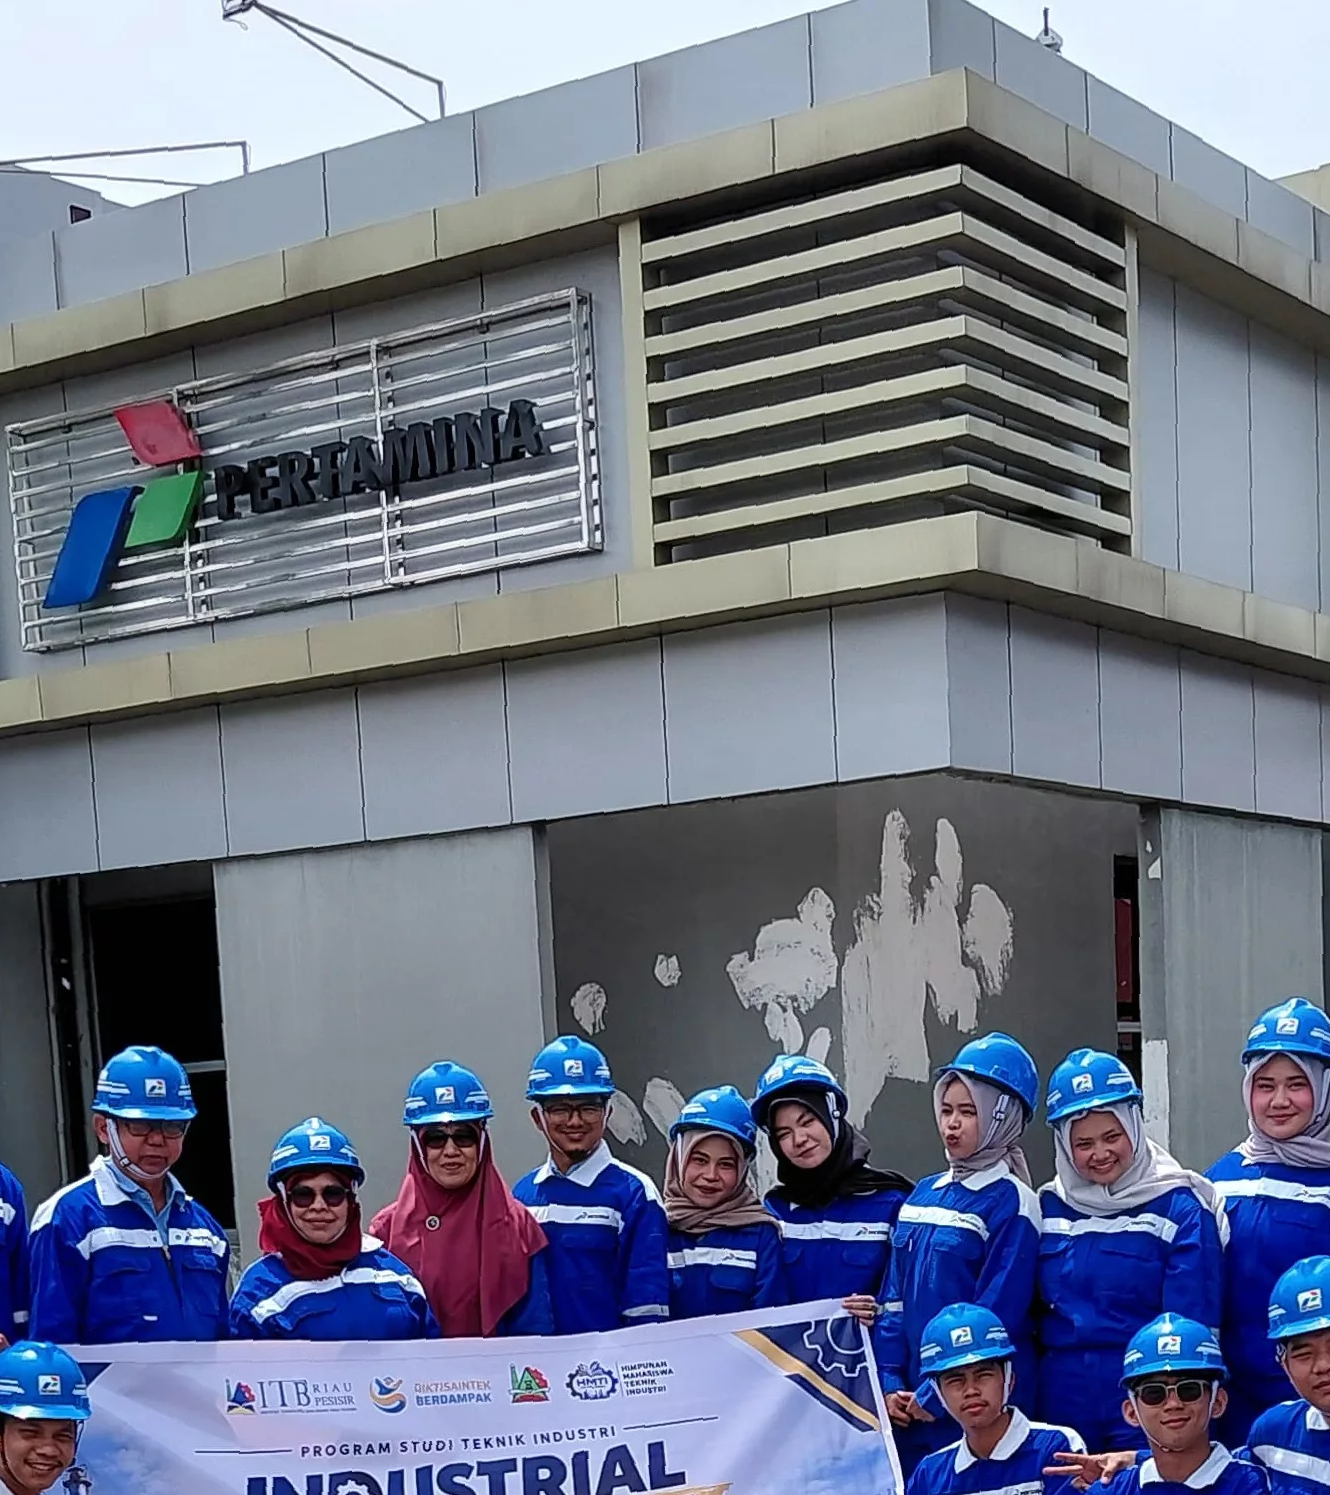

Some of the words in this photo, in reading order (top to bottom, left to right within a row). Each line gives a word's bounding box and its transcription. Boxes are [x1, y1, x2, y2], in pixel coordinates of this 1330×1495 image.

[214, 399, 548, 521] PERTAMINA
[623, 1368, 674, 1380] MAHASISWA
[312, 1382, 352, 1393] RIAU
[576, 1377, 608, 1387] HMTI
[624, 1378, 657, 1388] TEKNIK
[257, 1379, 311, 1408] ITB
[626, 1385, 667, 1396] INDUSTRI
[315, 1395, 355, 1406] PESISIR
[416, 1392, 492, 1406] BERDAMPAK
[301, 1441, 391, 1458] PROGRAM
[400, 1437, 454, 1453] STUDI
[461, 1433, 526, 1450] TEKNIK
[533, 1425, 616, 1445] INDUSTRI
